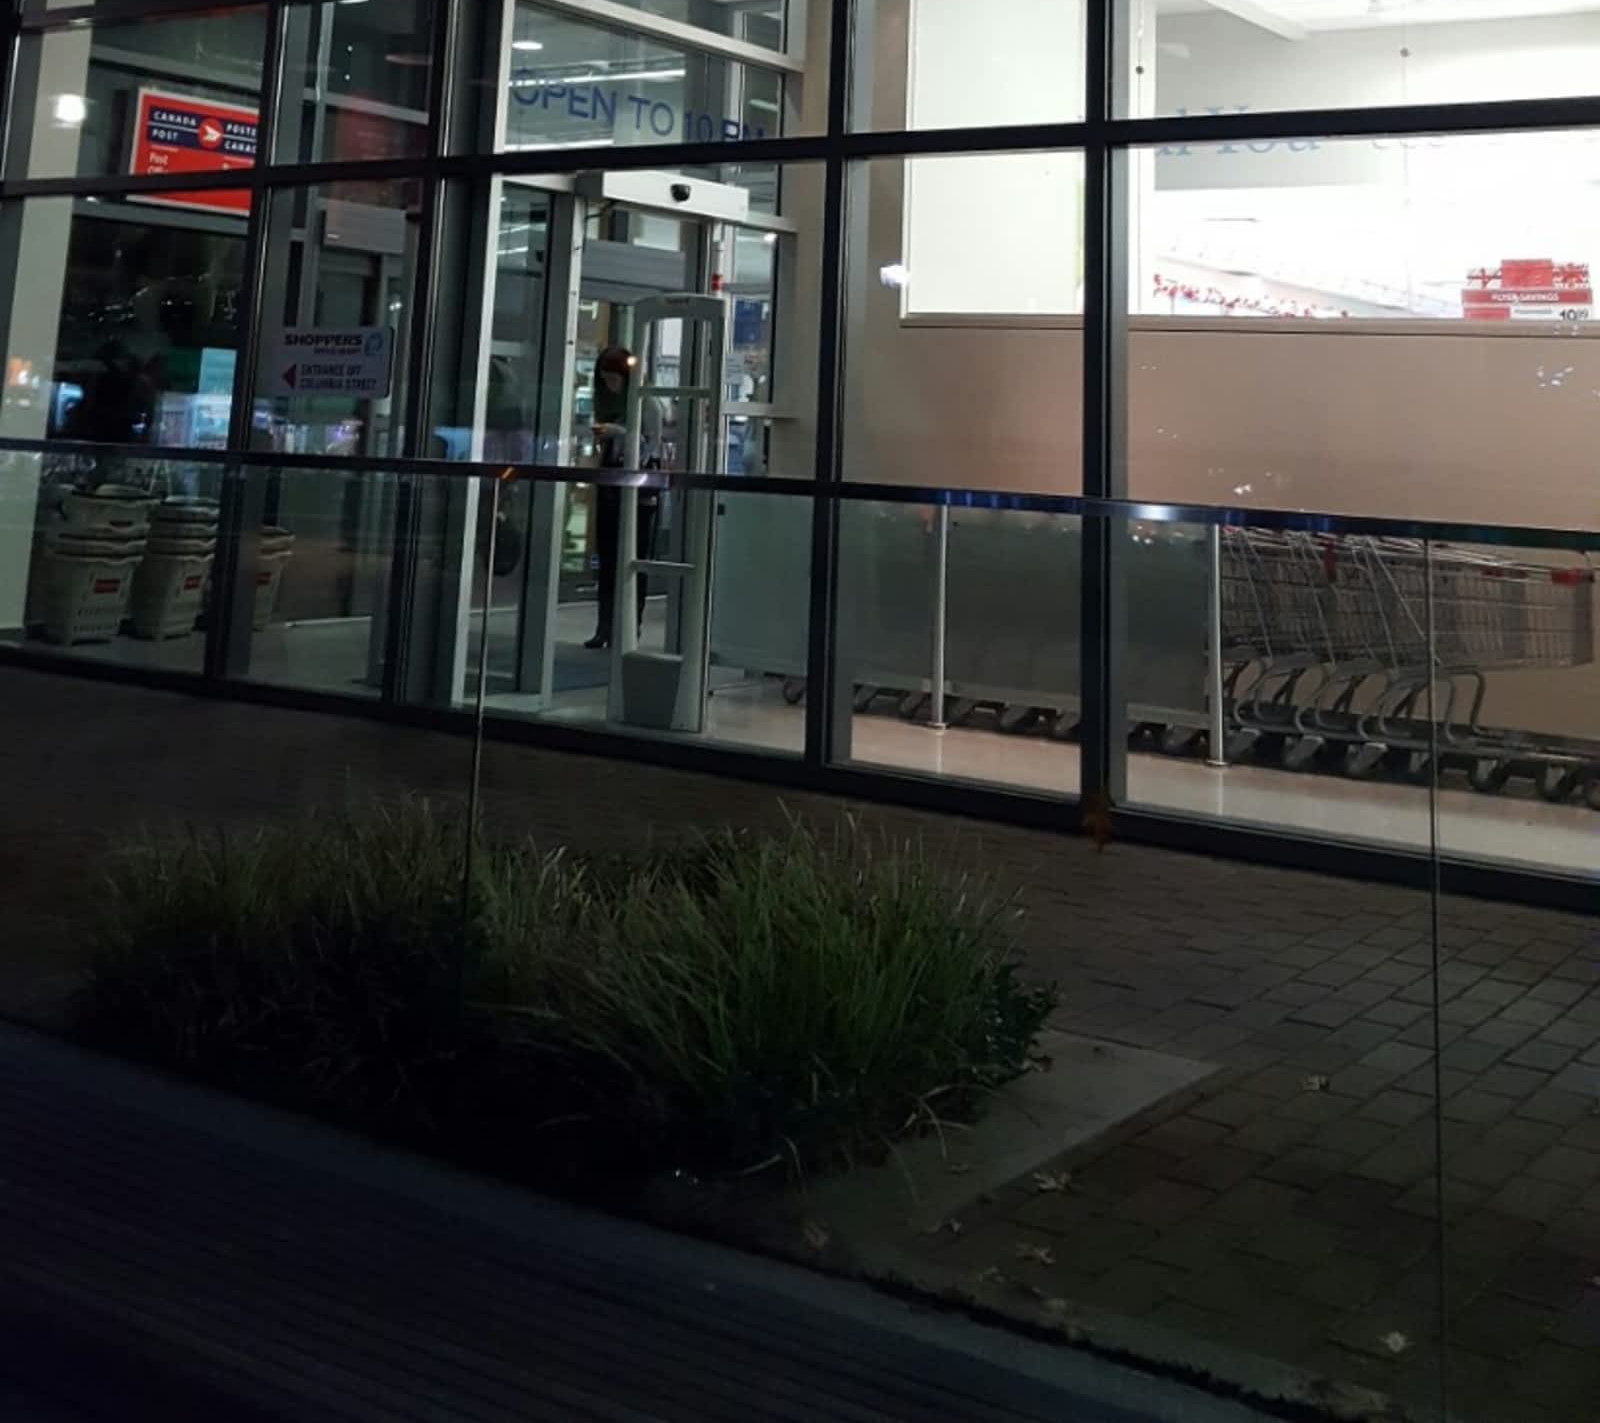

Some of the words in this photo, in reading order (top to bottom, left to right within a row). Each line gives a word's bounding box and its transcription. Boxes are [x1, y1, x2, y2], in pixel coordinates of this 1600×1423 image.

[511, 68, 617, 125] OPEN
[628, 95, 675, 137] TO
[153, 111, 196, 126] CANADA
[226, 123, 257, 137] POSTE
[151, 128, 179, 141] POST
[284, 333, 363, 347] SHOPPERS
